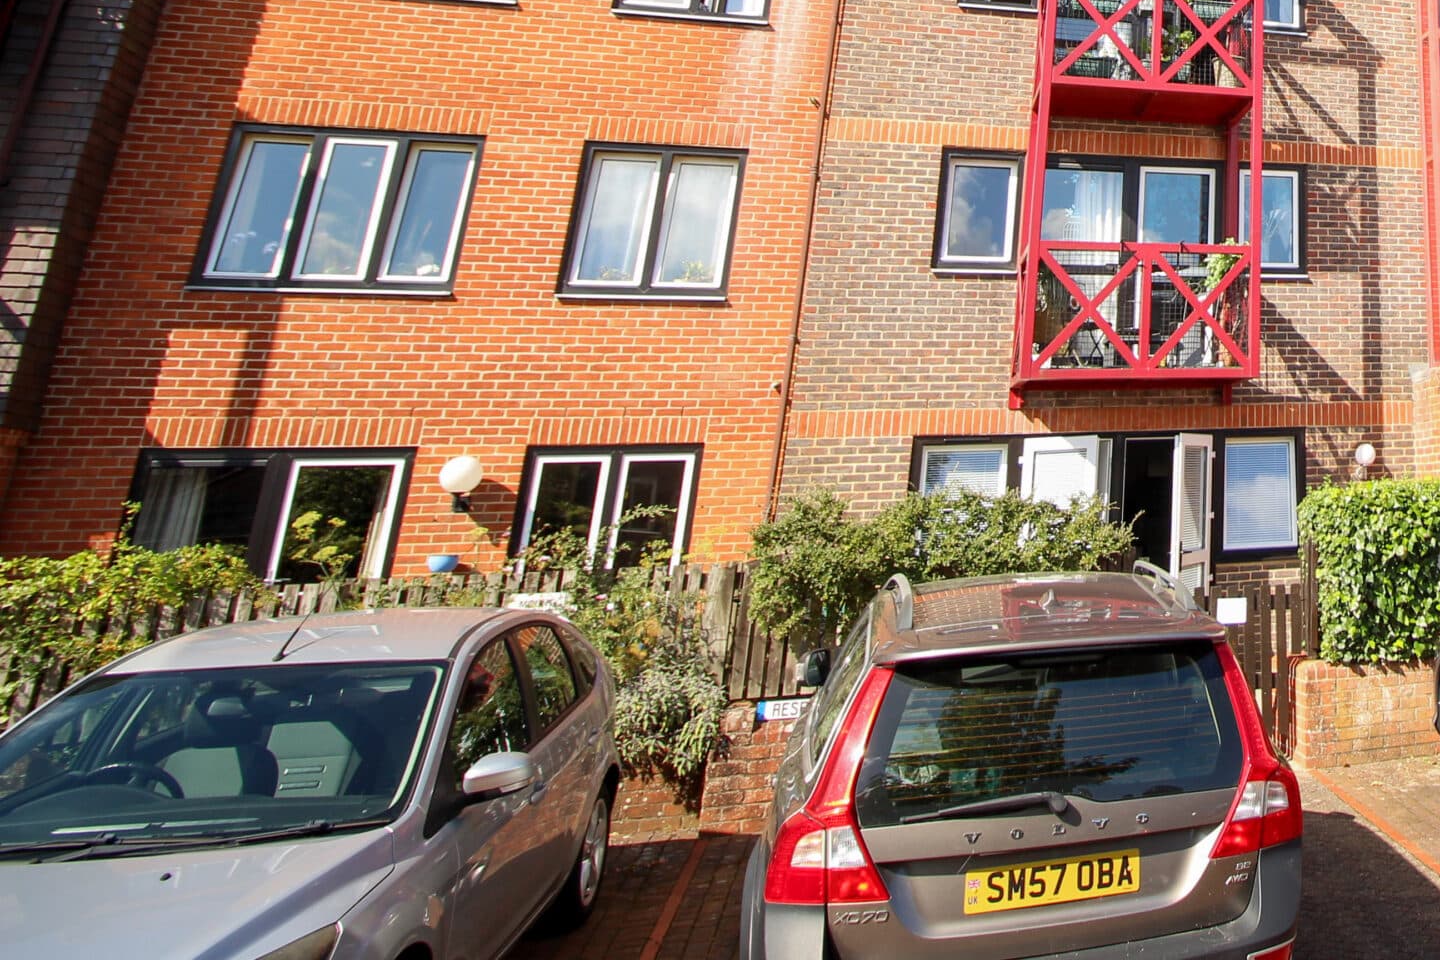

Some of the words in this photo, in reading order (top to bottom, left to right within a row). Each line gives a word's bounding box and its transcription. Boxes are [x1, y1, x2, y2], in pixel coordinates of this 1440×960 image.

[963, 813, 1150, 844] VOLVO
[986, 863, 1068, 904] SM57
[1076, 855, 1133, 891] OBA
[967, 895, 978, 905] UK
[833, 910, 890, 925] XC70
